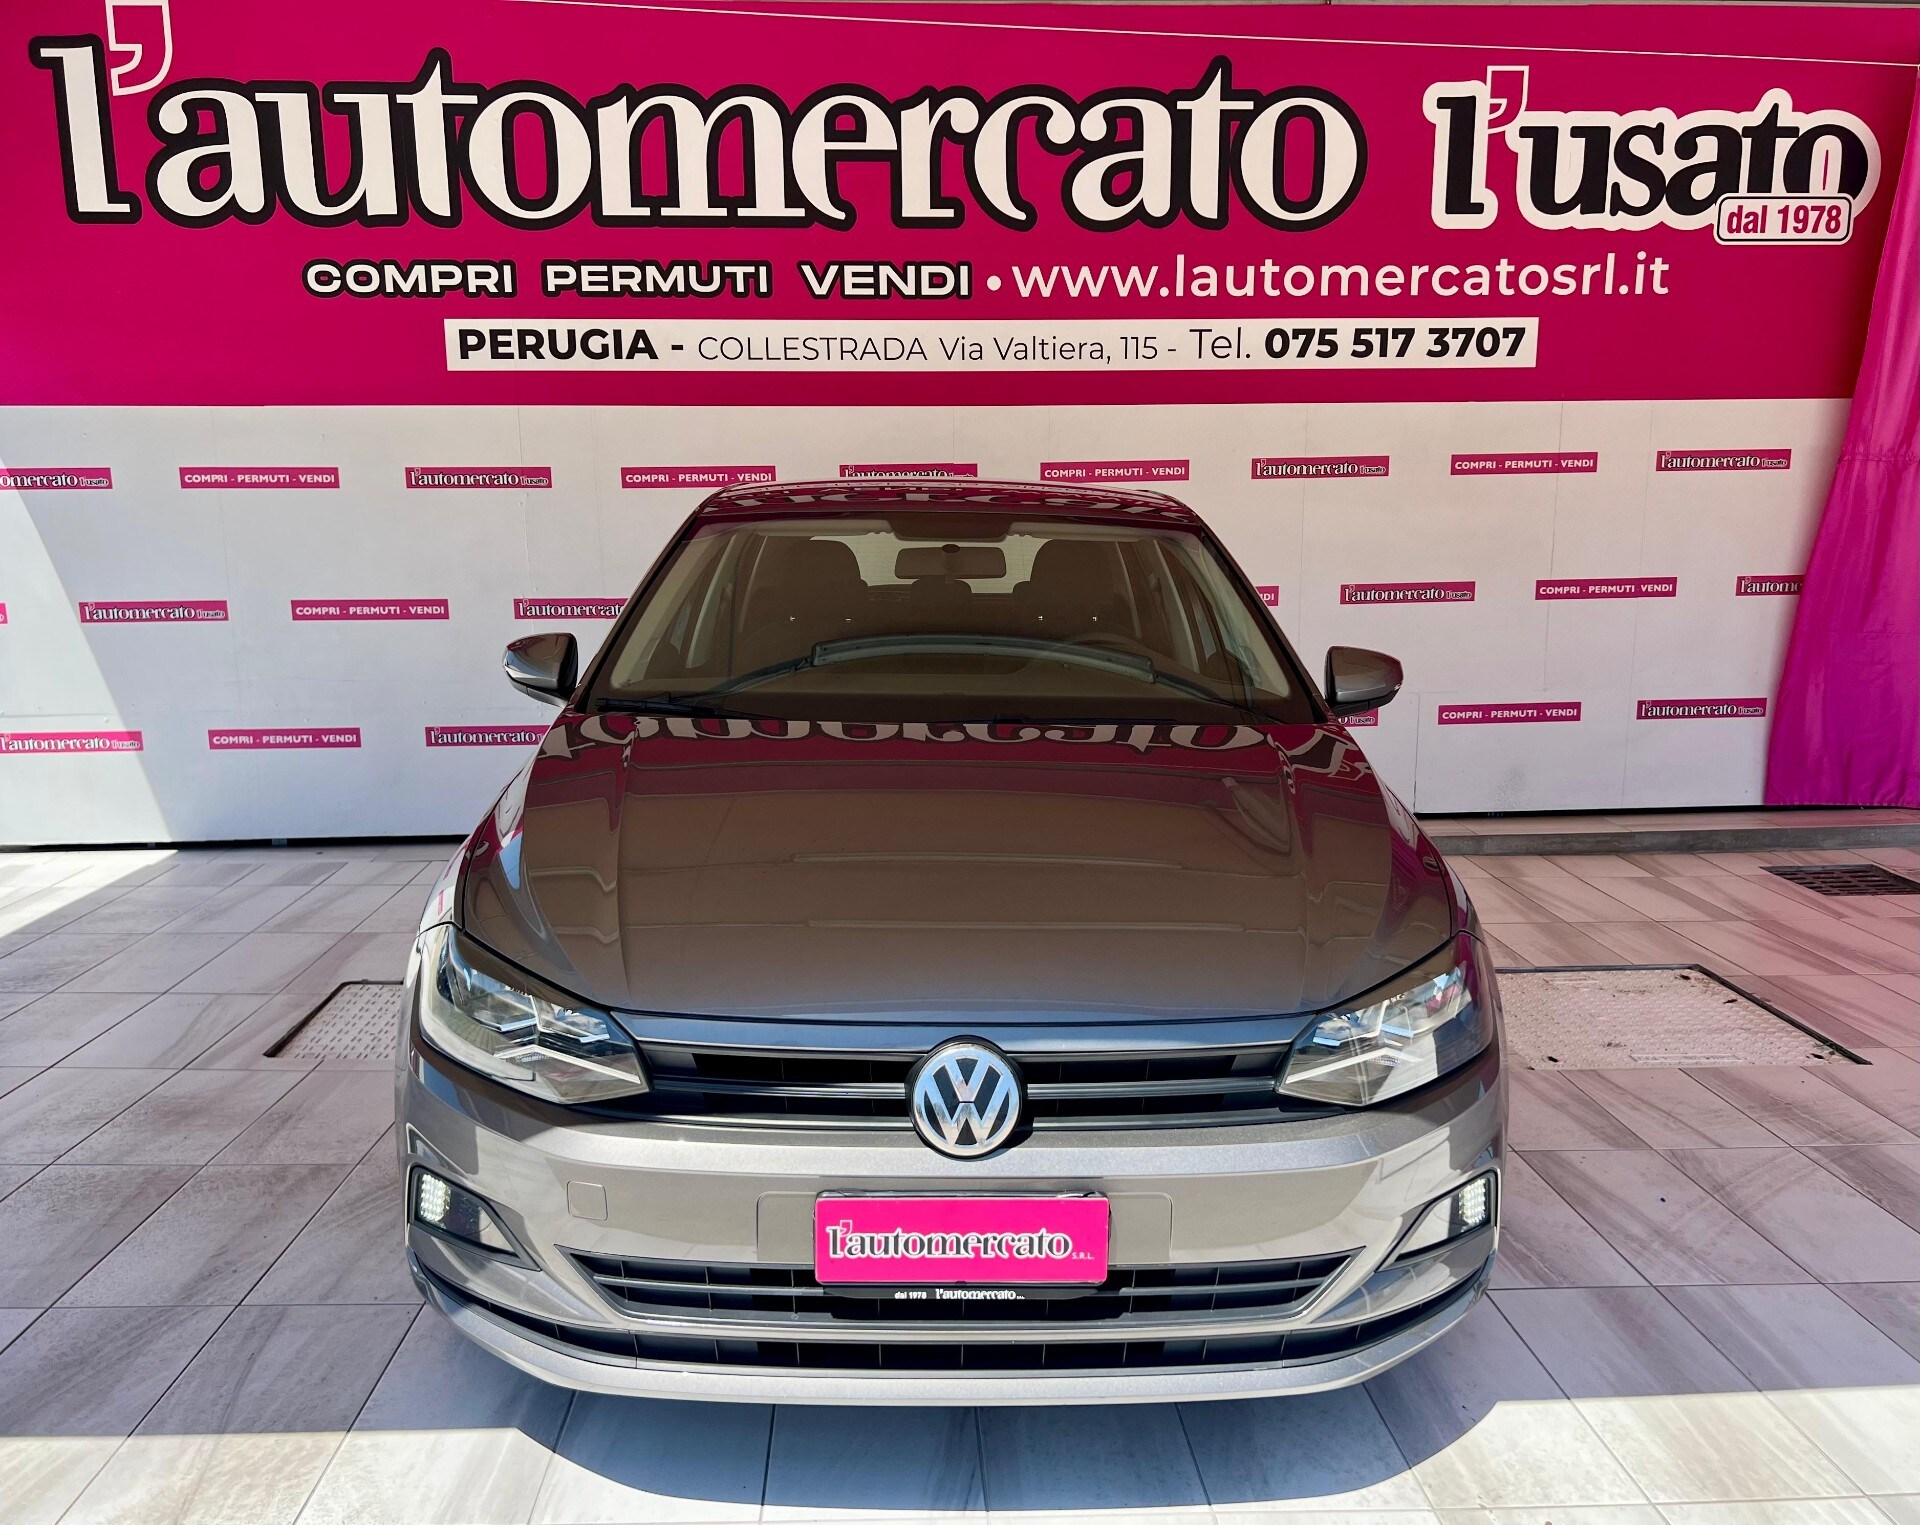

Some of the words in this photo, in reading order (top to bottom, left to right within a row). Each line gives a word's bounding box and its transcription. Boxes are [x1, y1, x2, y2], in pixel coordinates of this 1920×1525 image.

[30, 1, 1365, 228] l'automercato
[1424, 65, 1880, 231] l'usato
[1726, 204, 1767, 234] dal
[1776, 204, 1842, 234] 1978
[305, 262, 514, 294] COMPRI
[546, 262, 770, 295] PERMUTI
[799, 262, 970, 297] VENDI
[1011, 252, 1670, 298] www.lautomercatosrl.it
[458, 328, 658, 360] PERUGIA
[698, 336, 928, 361] COLLESTRADA
[939, 336, 983, 361] Via
[992, 334, 1111, 365] Valtiera,
[1120, 336, 1159, 360] 115
[1189, 328, 1252, 360] Tel.
[1264, 328, 1339, 360] 075
[1350, 328, 1415, 360] 517
[1425, 326, 1526, 359] 3707
[1256, 459, 1358, 476] l'automercato
[1455, 461, 1496, 470] COMPRI
[1505, 460, 1552, 468] PERMUTI
[1561, 459, 1593, 467] VENDI
[1661, 451, 1760, 468] l'automercato
[184, 474, 227, 483] COMPRI
[238, 474, 289, 483] PERMUTI
[299, 475, 334, 483] VENDI
[410, 468, 518, 486] l'automercato
[625, 474, 669, 482] COMPRI
[678, 474, 728, 482] PERMUTI
[737, 473, 771, 481] VENDI
[1044, 469, 1085, 477] COMPRI
[1095, 468, 1142, 477] PERMUTI
[1152, 467, 1184, 475] VENDI
[1344, 585, 1444, 602] l'automercato
[1539, 586, 1580, 595] COMPRI
[1588, 585, 1634, 593] PERMUTI
[1641, 584, 1672, 592] VENDI
[84, 602, 195, 620] l'automercato
[295, 607, 339, 615] COMPRI
[350, 606, 400, 615] PERMUTI
[409, 606, 444, 614] VENDI
[518, 599, 624, 616] l'automercat
[1442, 711, 1482, 719] COMPRI
[1491, 710, 1537, 718] PERMUTI
[1545, 709, 1577, 717] VENDI
[1641, 701, 1736, 717] l'automercato
[0, 734, 110, 750] l'automercato
[262, 735, 312, 744] PERMUTI
[322, 734, 356, 742] VENDI
[430, 727, 535, 744] l'automercato
[826, 1220, 1072, 1259] l'automercato
[1071, 1252, 1095, 1260] S.R.L.
[895, 1291, 907, 1299] dal
[909, 1291, 927, 1299] 1978
[935, 1288, 1016, 1300] l'automercato
